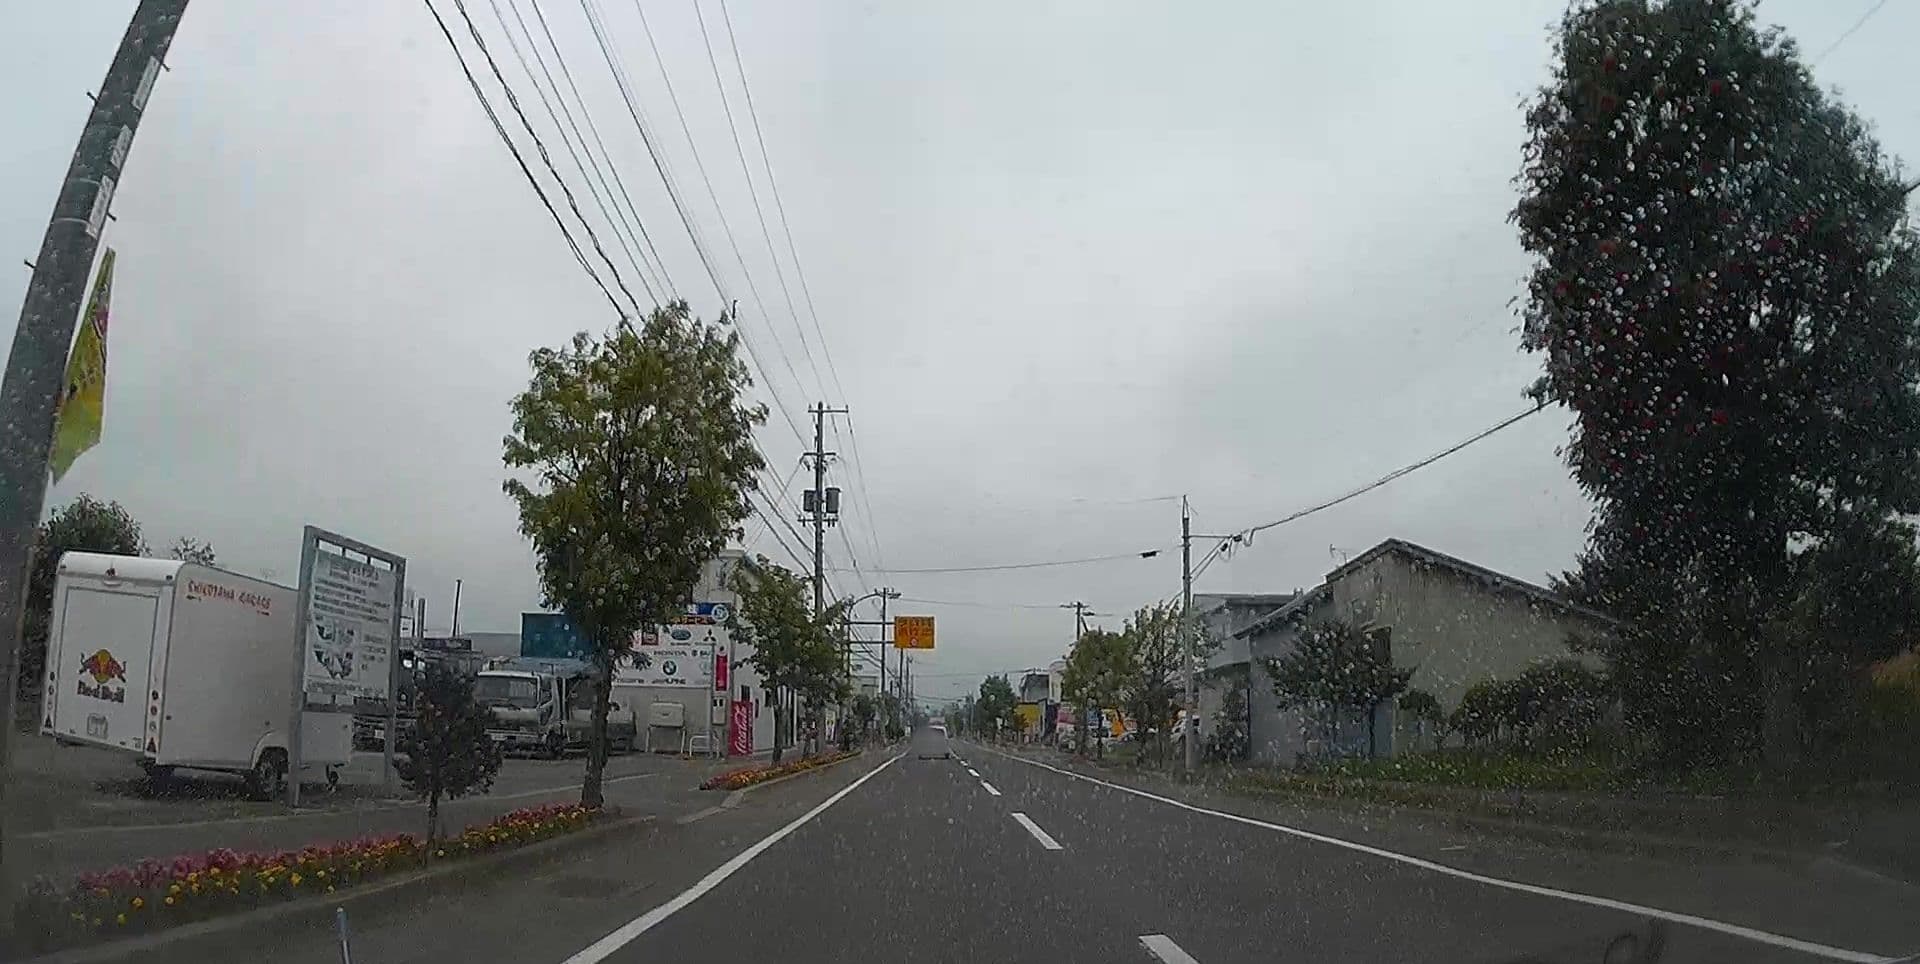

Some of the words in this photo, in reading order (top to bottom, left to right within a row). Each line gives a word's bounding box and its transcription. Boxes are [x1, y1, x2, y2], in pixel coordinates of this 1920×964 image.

[653, 649, 688, 657] HONDA
[77, 679, 100, 699] Red
[102, 685, 124, 704] Bull
